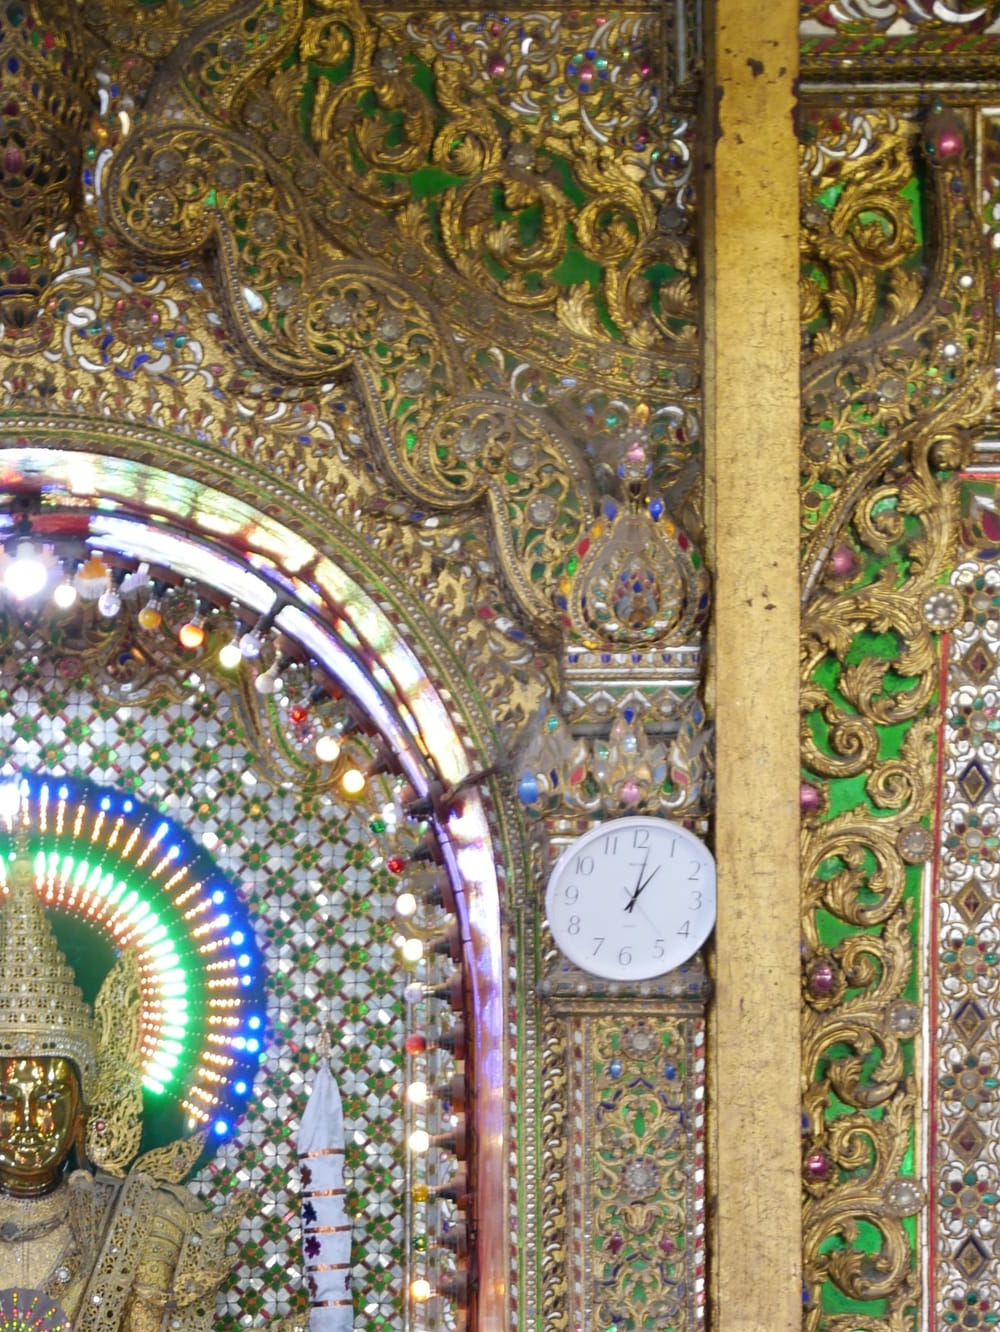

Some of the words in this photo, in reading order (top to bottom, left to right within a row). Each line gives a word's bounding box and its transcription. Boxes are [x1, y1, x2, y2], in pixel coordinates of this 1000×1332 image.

[603, 836, 618, 855] 11
[632, 829, 649, 849] 12
[575, 856, 595, 876] 10
[687, 860, 701, 881] 2
[563, 884, 579, 906] 9
[688, 890, 702, 911] 3
[567, 915, 581, 935] 8
[675, 919, 691, 939] 4
[592, 937, 605, 957] 7
[618, 945, 633, 967] 6
[653, 939, 665, 959] 5
